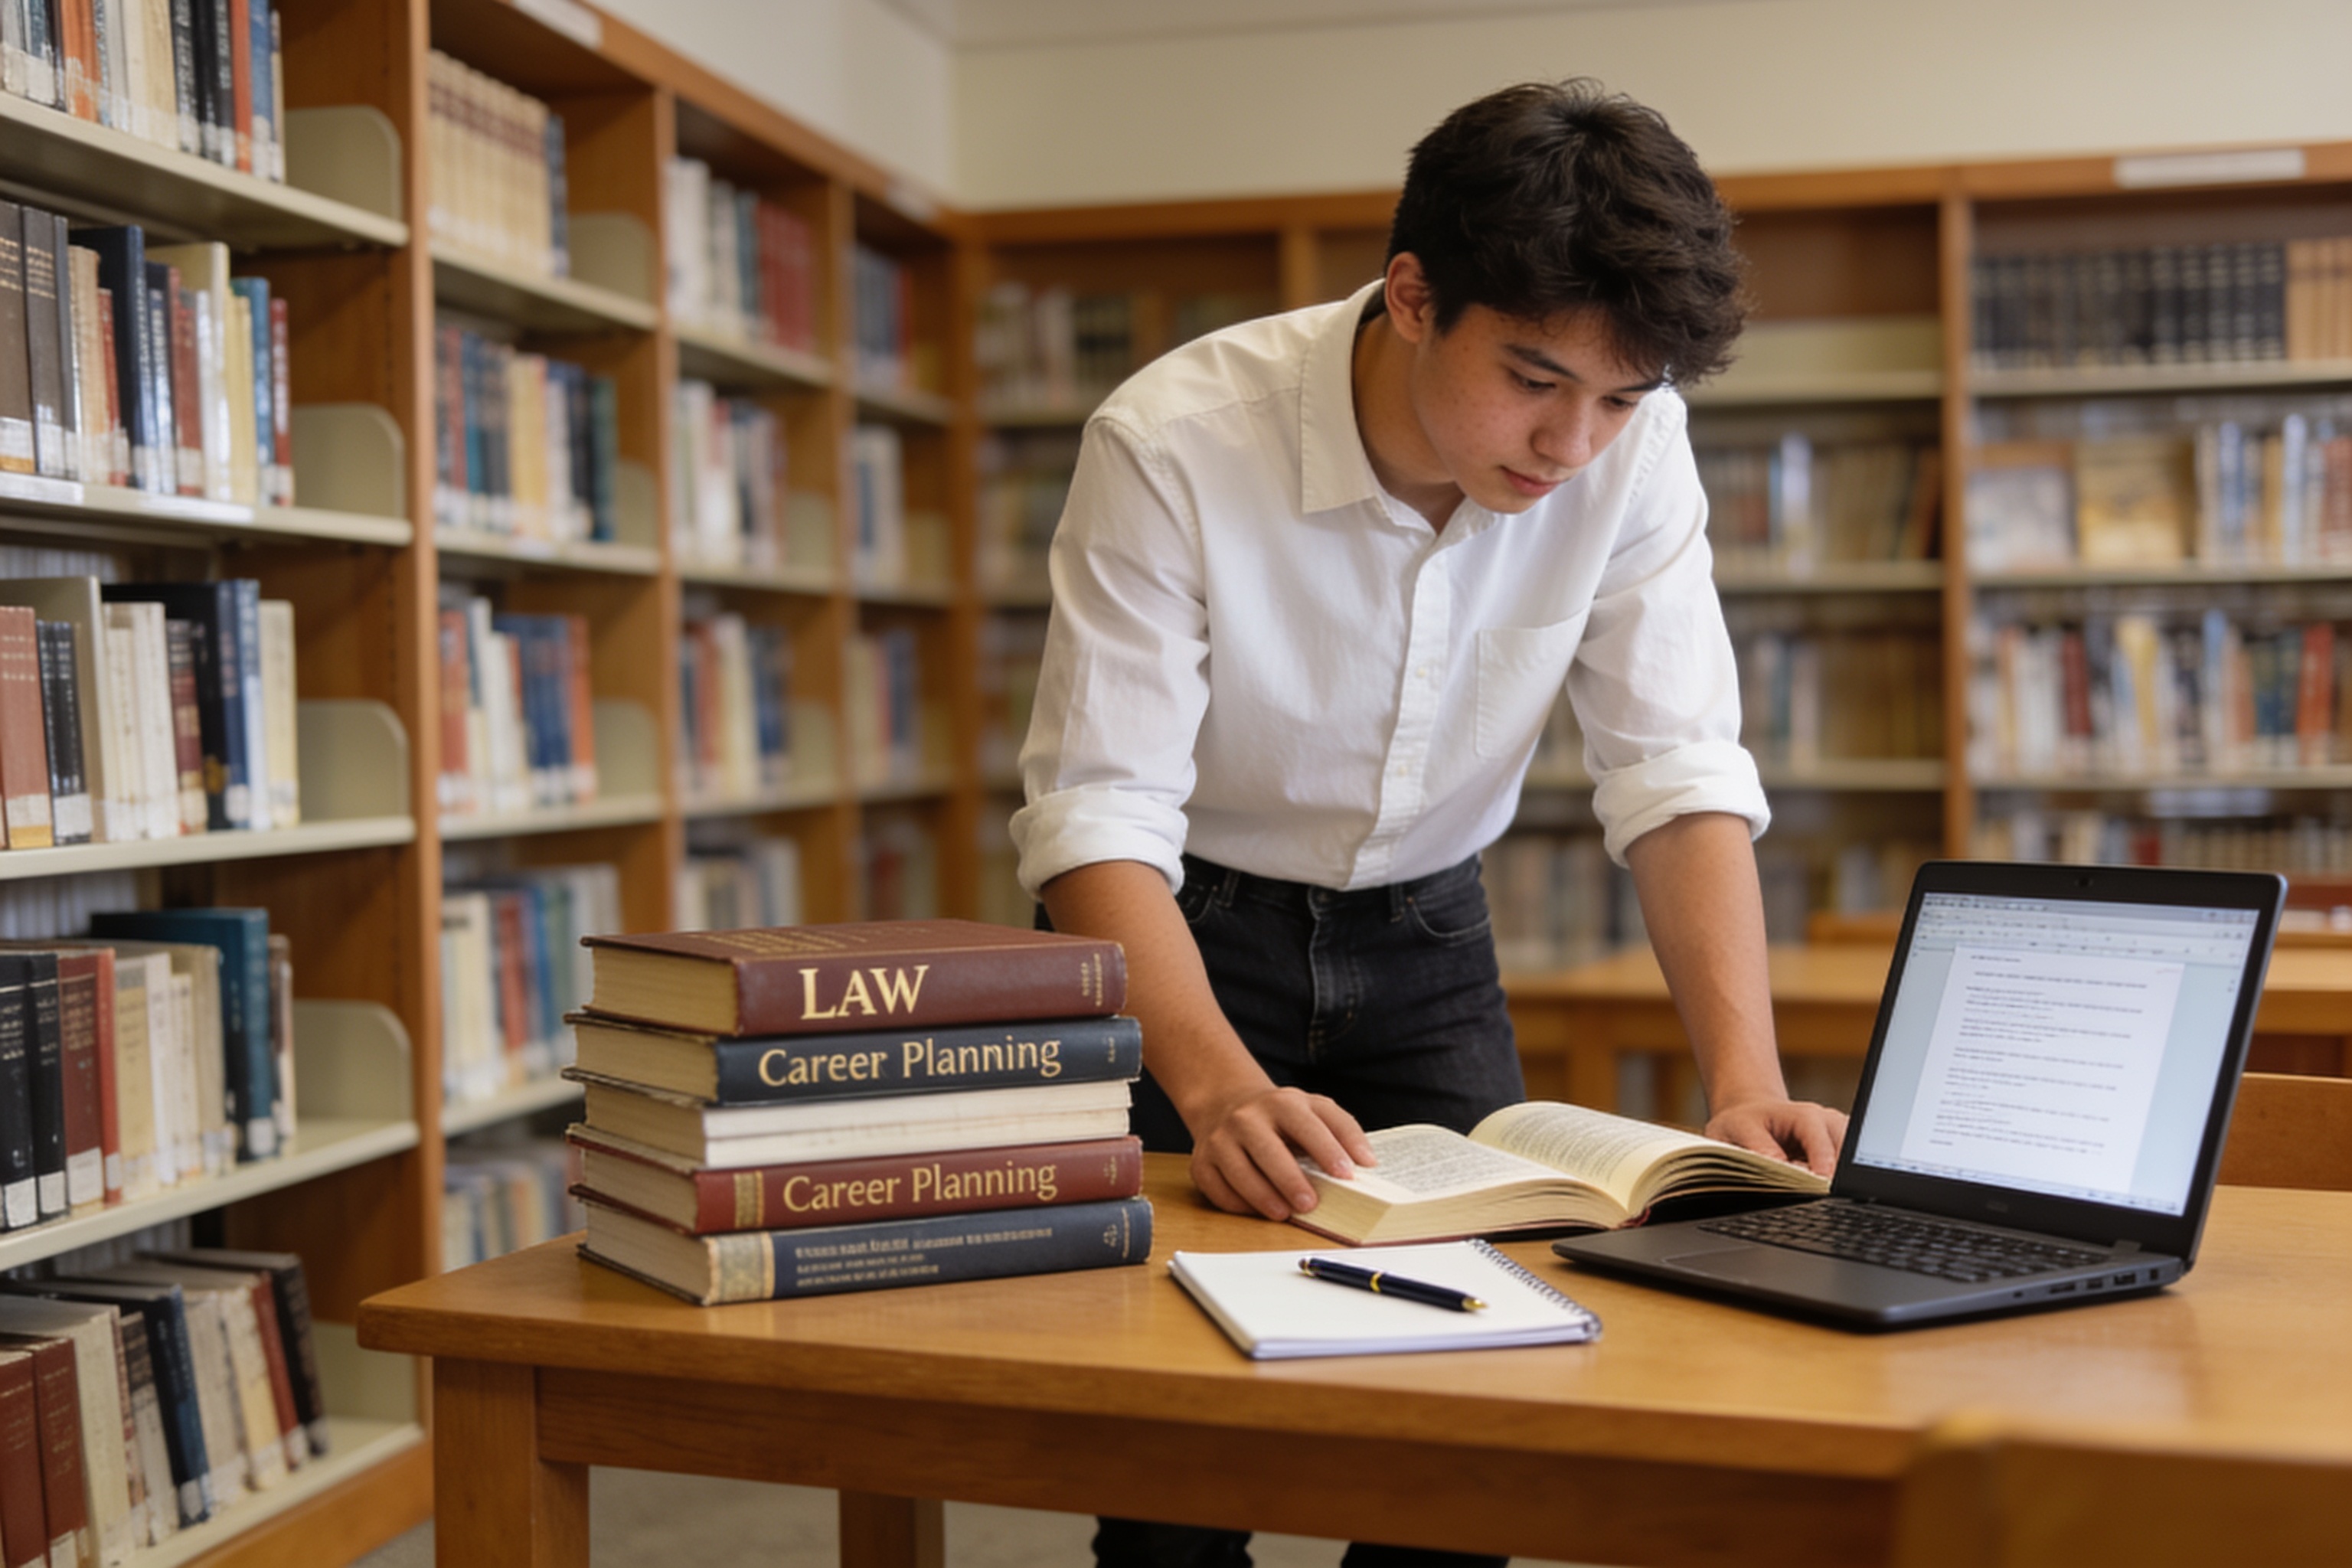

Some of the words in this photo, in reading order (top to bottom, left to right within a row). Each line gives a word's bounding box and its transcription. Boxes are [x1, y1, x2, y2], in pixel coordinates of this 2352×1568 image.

[799, 965, 929, 1020] LAW
[758, 1048, 888, 1087] Career
[902, 1036, 1062, 1078] Planning
[782, 1174, 902, 1213] Career
[911, 1160, 1058, 1202] Planning
